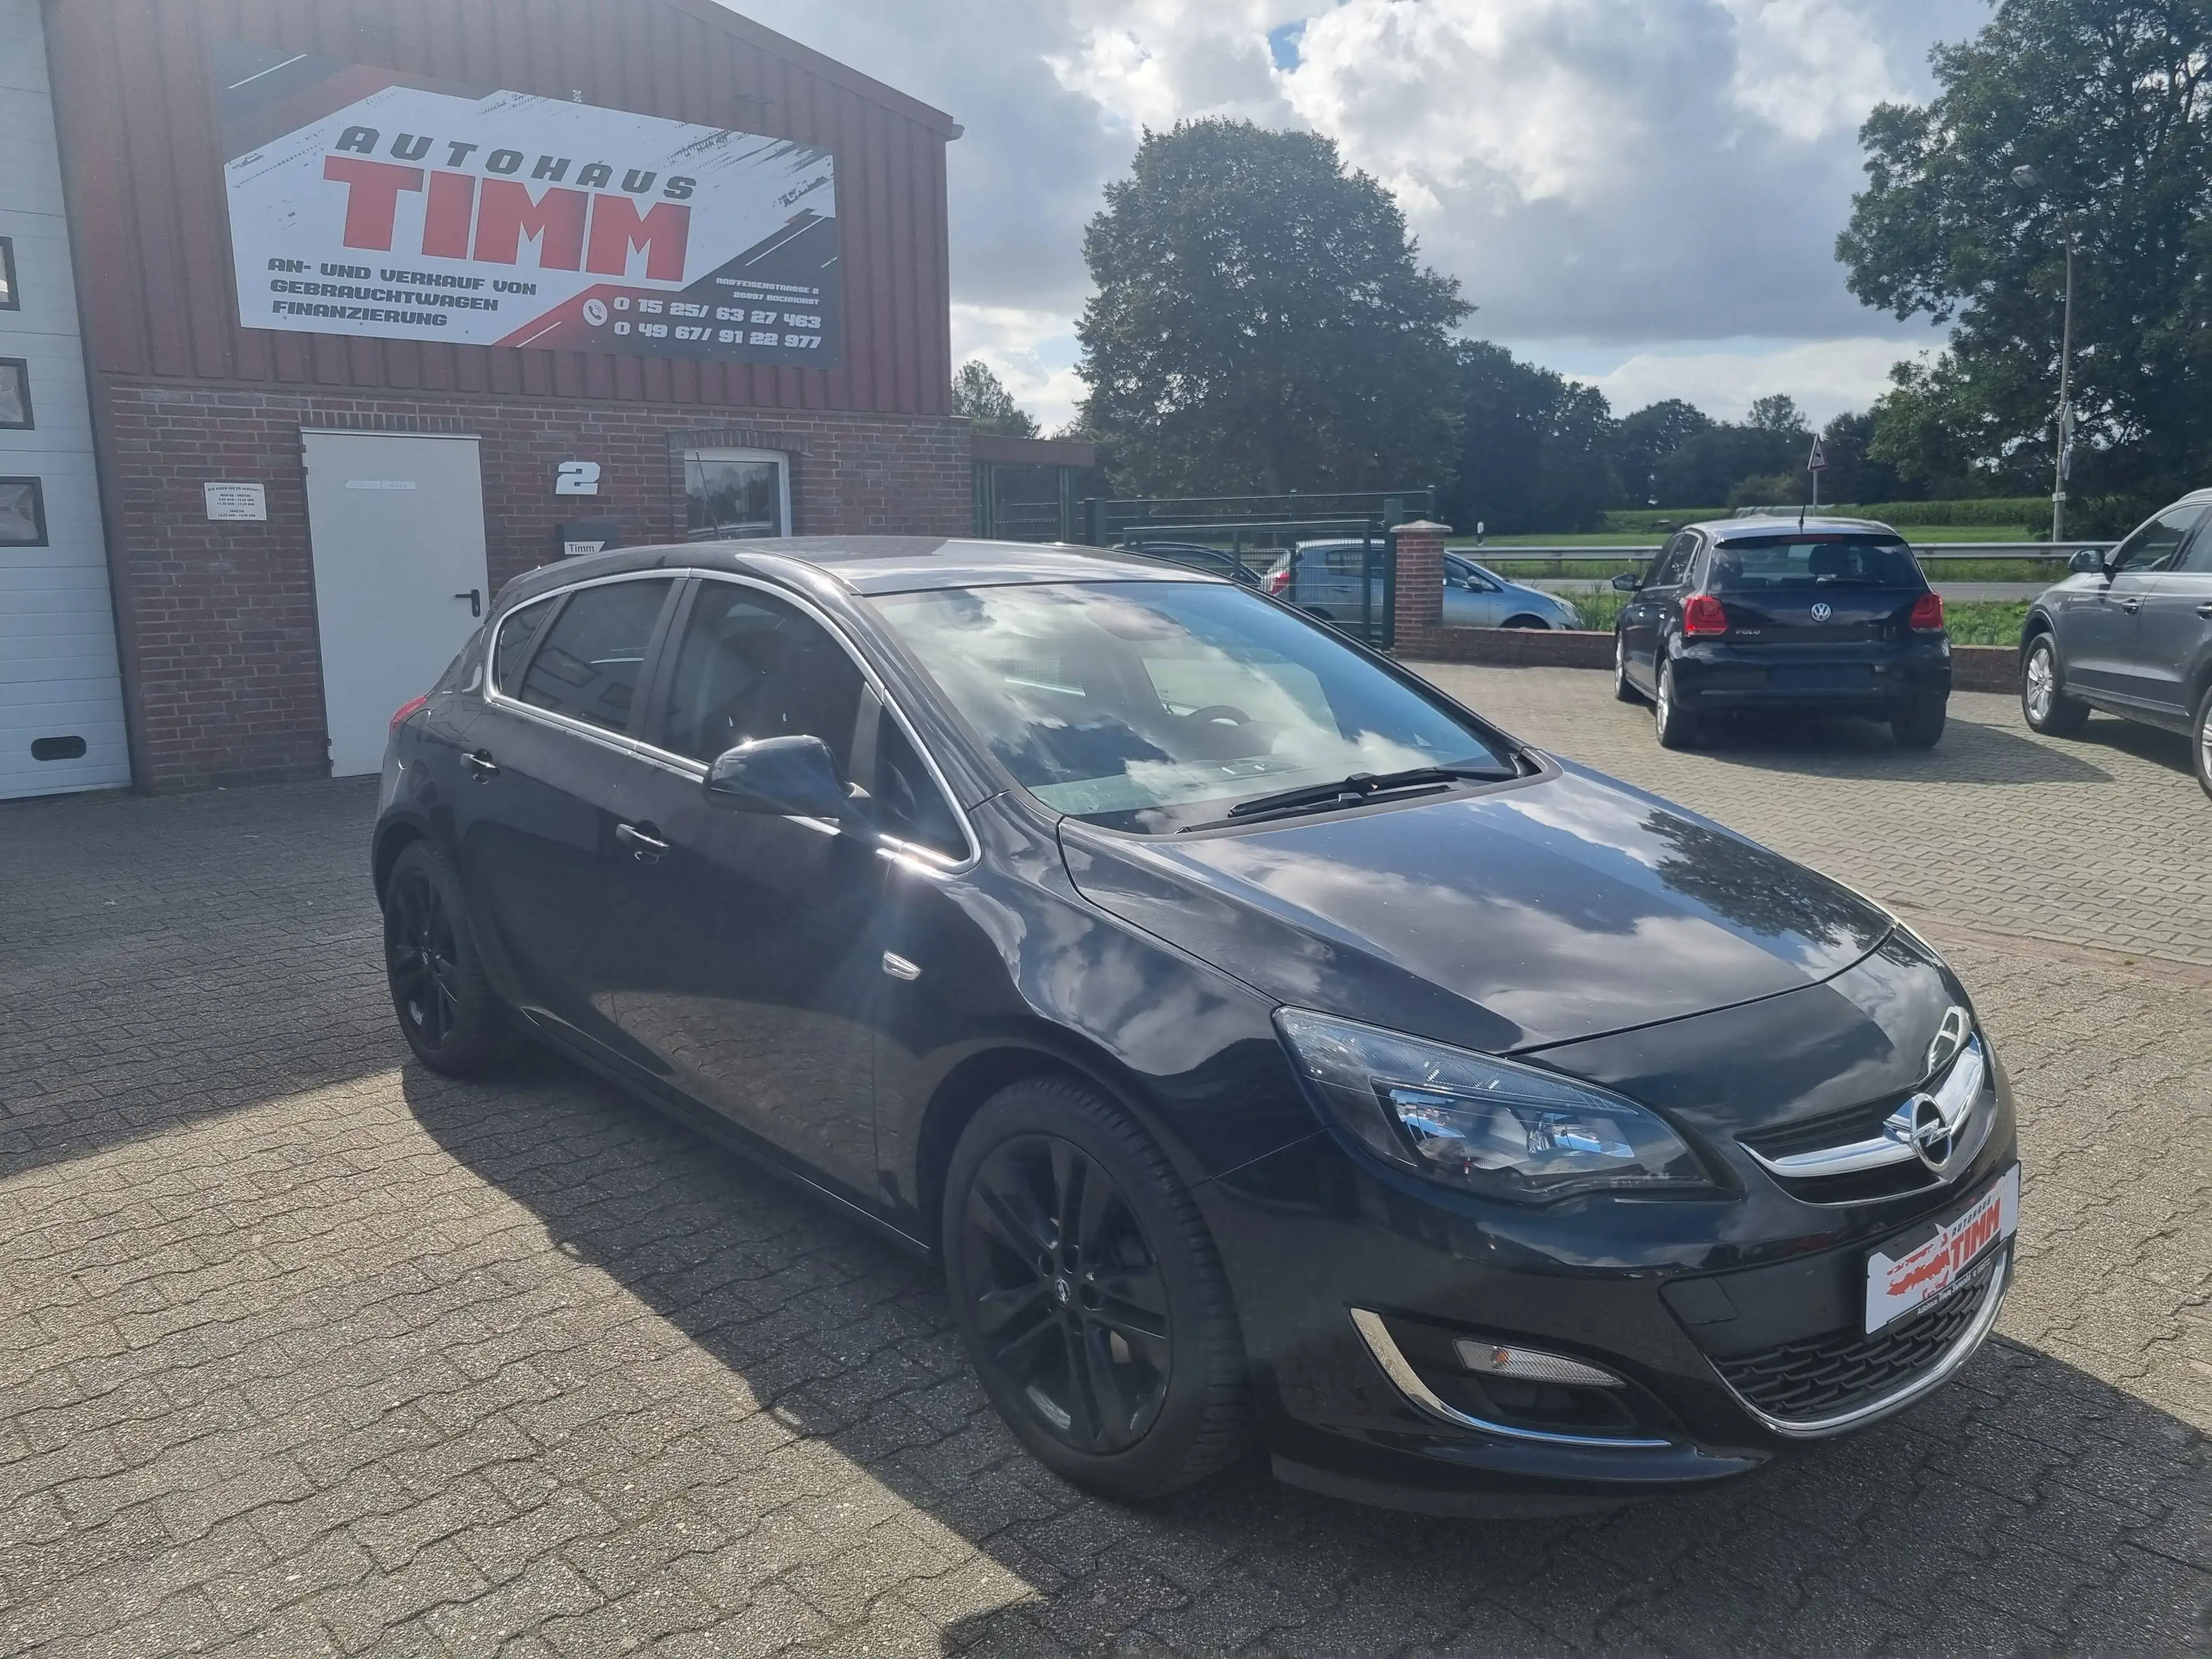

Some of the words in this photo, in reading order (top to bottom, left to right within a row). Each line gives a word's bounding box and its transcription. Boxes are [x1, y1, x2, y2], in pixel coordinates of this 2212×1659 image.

[335, 125, 697, 200] AUTOHAUS
[323, 154, 692, 283] TIMM
[268, 257, 311, 274] AN-
[320, 263, 372, 280] UND
[380, 268, 486, 290] VERKAUF
[493, 280, 537, 296] VON
[716, 278, 810, 294] RAIFFEISENSTRASSE
[270, 279, 499, 312] GEBRAUCHTWAGEN
[766, 294, 820, 305] BOCKHORST
[272, 300, 448, 327] FINANZIERUNG
[613, 297, 630, 310] 0
[638, 298, 663, 313] 15
[669, 302, 710, 319] 25/
[716, 307, 745, 322] 63
[750, 310, 777, 324] 27
[783, 313, 821, 328] 463
[614, 321, 630, 335] 0
[638, 323, 668, 338] 49
[675, 325, 712, 342] 67/
[718, 329, 744, 344] 91
[749, 332, 778, 346] 22
[784, 334, 822, 349] 977
[555, 461, 601, 495] 2
[569, 544, 594, 553] Timm
[1811, 603, 1831, 622] VW
[1951, 1196, 1991, 1237] AUTOHAUS
[1950, 1197, 2001, 1272] TIMM
